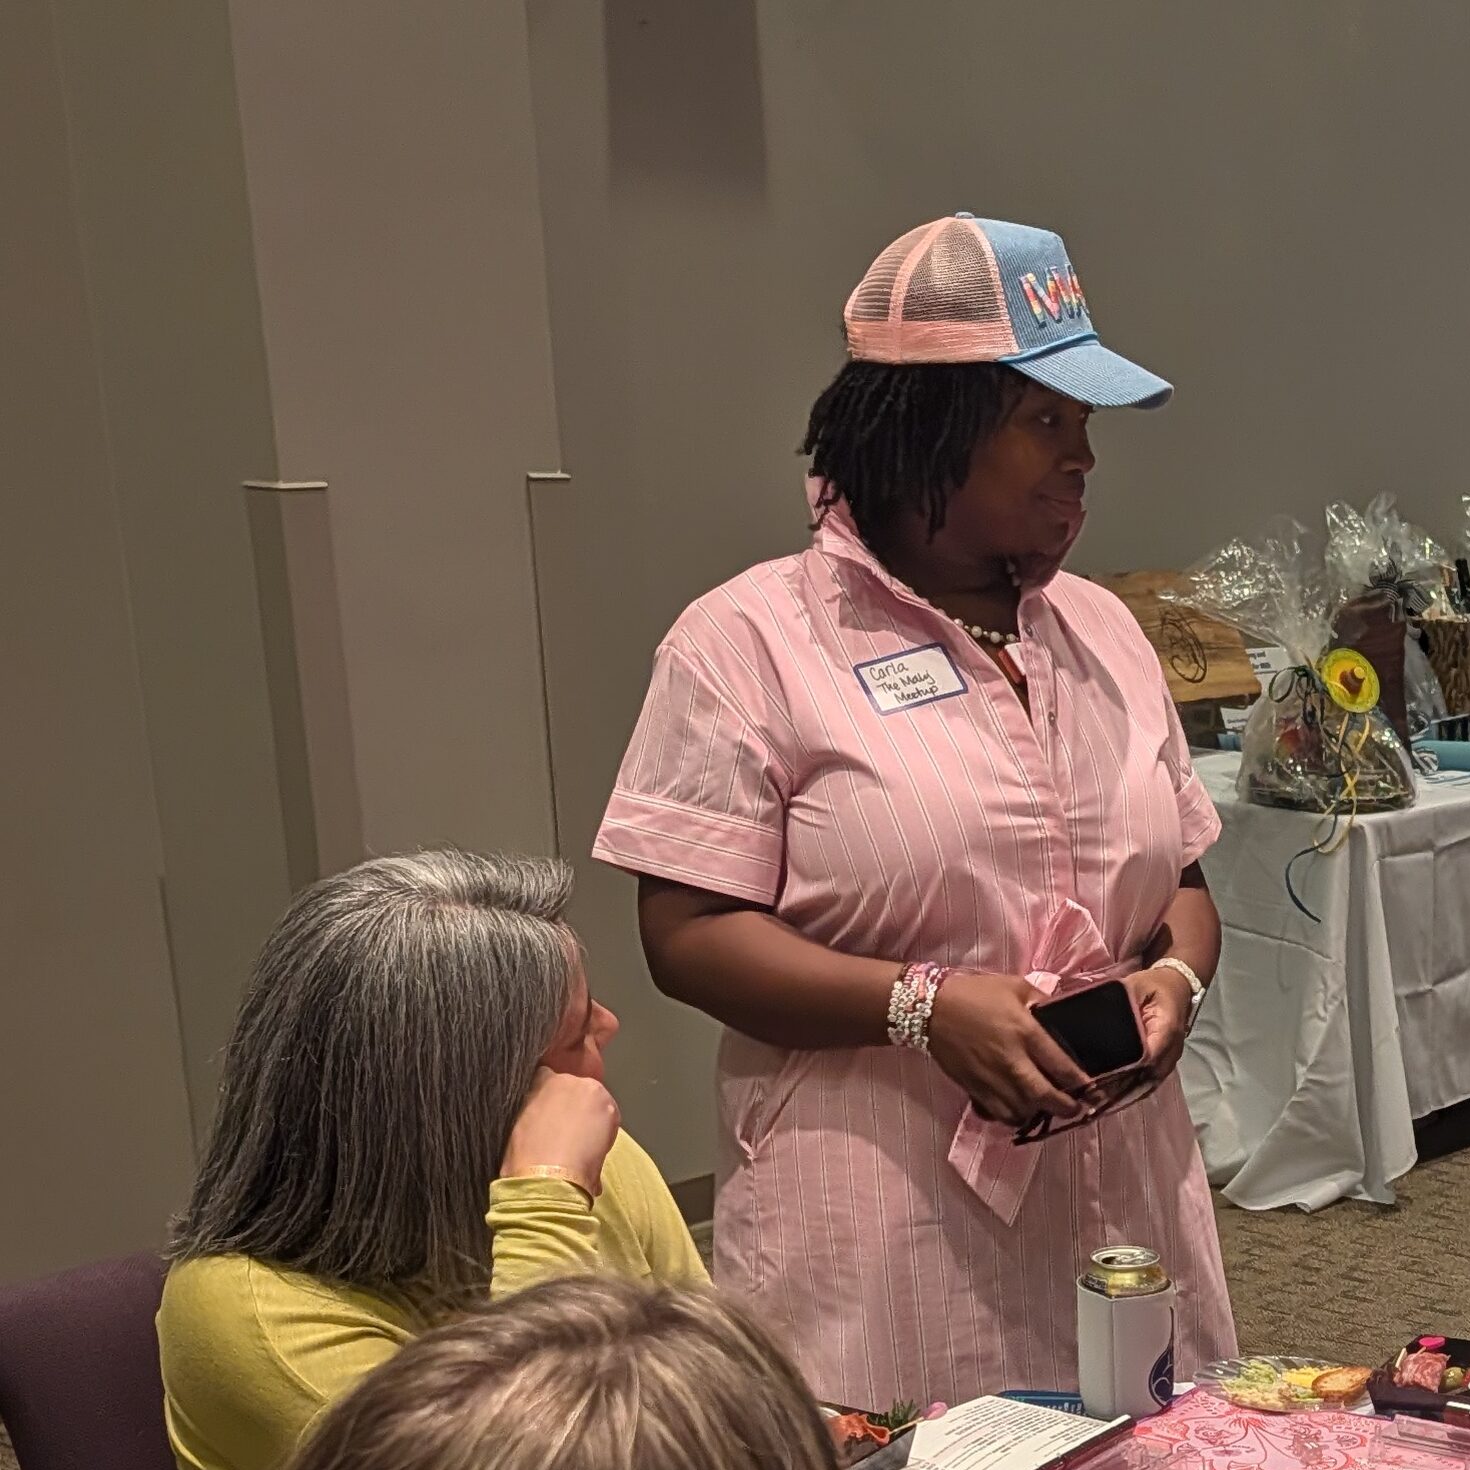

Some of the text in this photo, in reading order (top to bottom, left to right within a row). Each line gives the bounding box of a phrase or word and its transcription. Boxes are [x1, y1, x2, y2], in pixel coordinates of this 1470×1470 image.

[869, 663, 909, 681] Carla
[876, 681, 900, 694] The
[894, 685, 939, 704] Meetup
